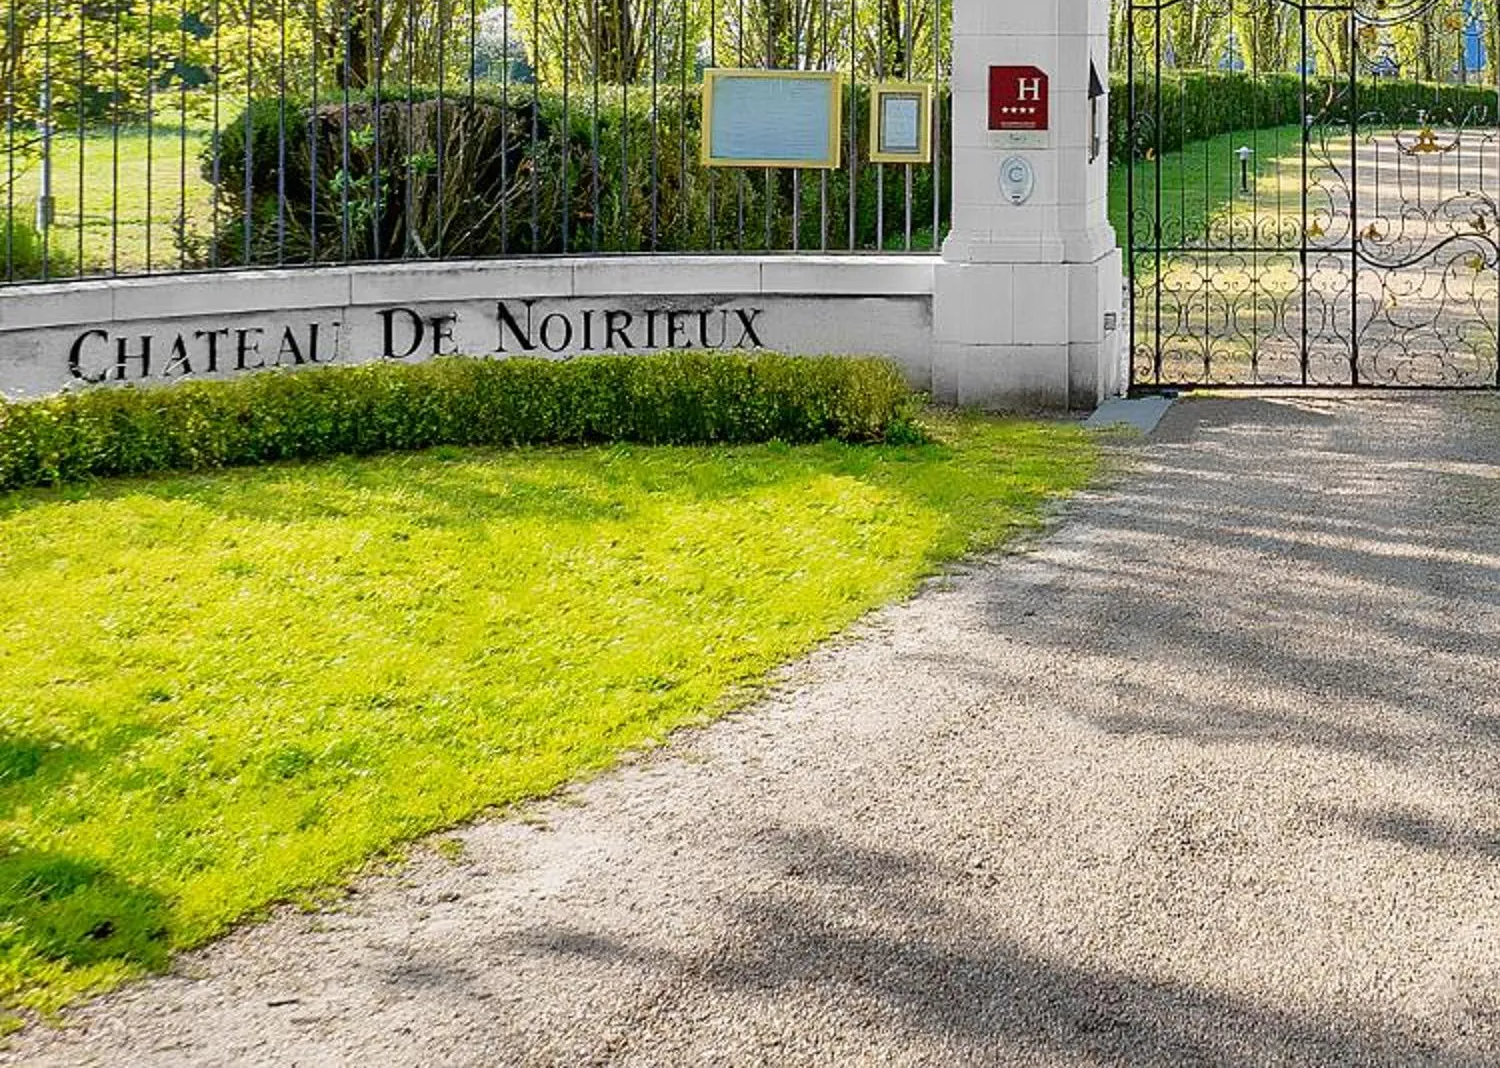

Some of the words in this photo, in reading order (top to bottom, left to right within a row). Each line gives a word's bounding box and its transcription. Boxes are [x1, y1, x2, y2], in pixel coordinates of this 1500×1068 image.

[1016, 77, 1041, 101] H
[68, 321, 343, 383] CHATEAU
[375, 307, 461, 359] DE
[494, 299, 765, 353] NOIRIEUX
